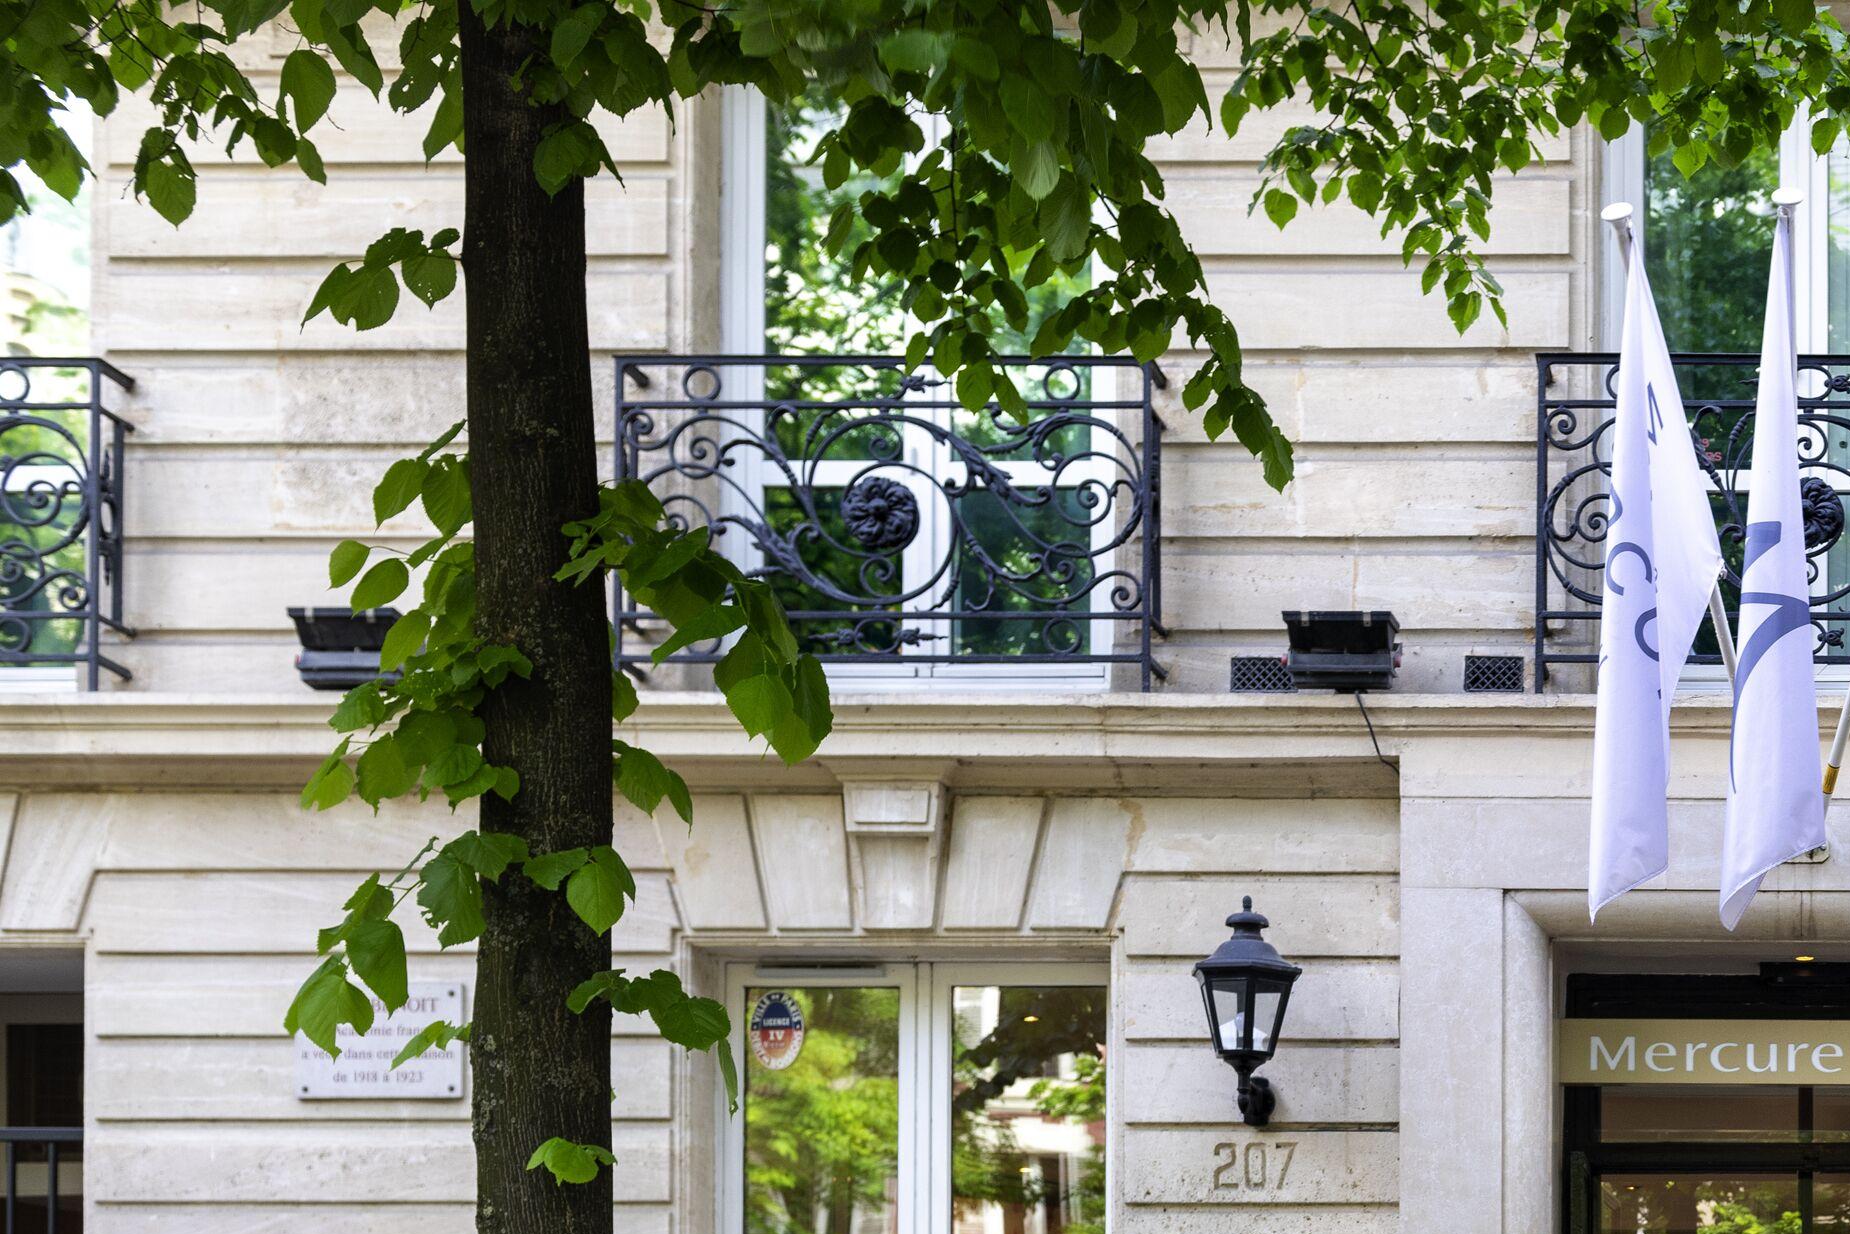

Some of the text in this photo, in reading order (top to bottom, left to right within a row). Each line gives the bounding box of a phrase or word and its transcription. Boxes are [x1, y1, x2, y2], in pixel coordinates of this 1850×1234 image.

[763, 1017, 790, 1027] LICENCE
[768, 1030, 785, 1041] IV
[344, 1048, 372, 1059] dans
[376, 1049, 398, 1059] cett
[1589, 1035, 1845, 1073] Mercure
[332, 1071, 347, 1083] de
[396, 1071, 424, 1083] 1923
[1213, 1141, 1298, 1191] 207
